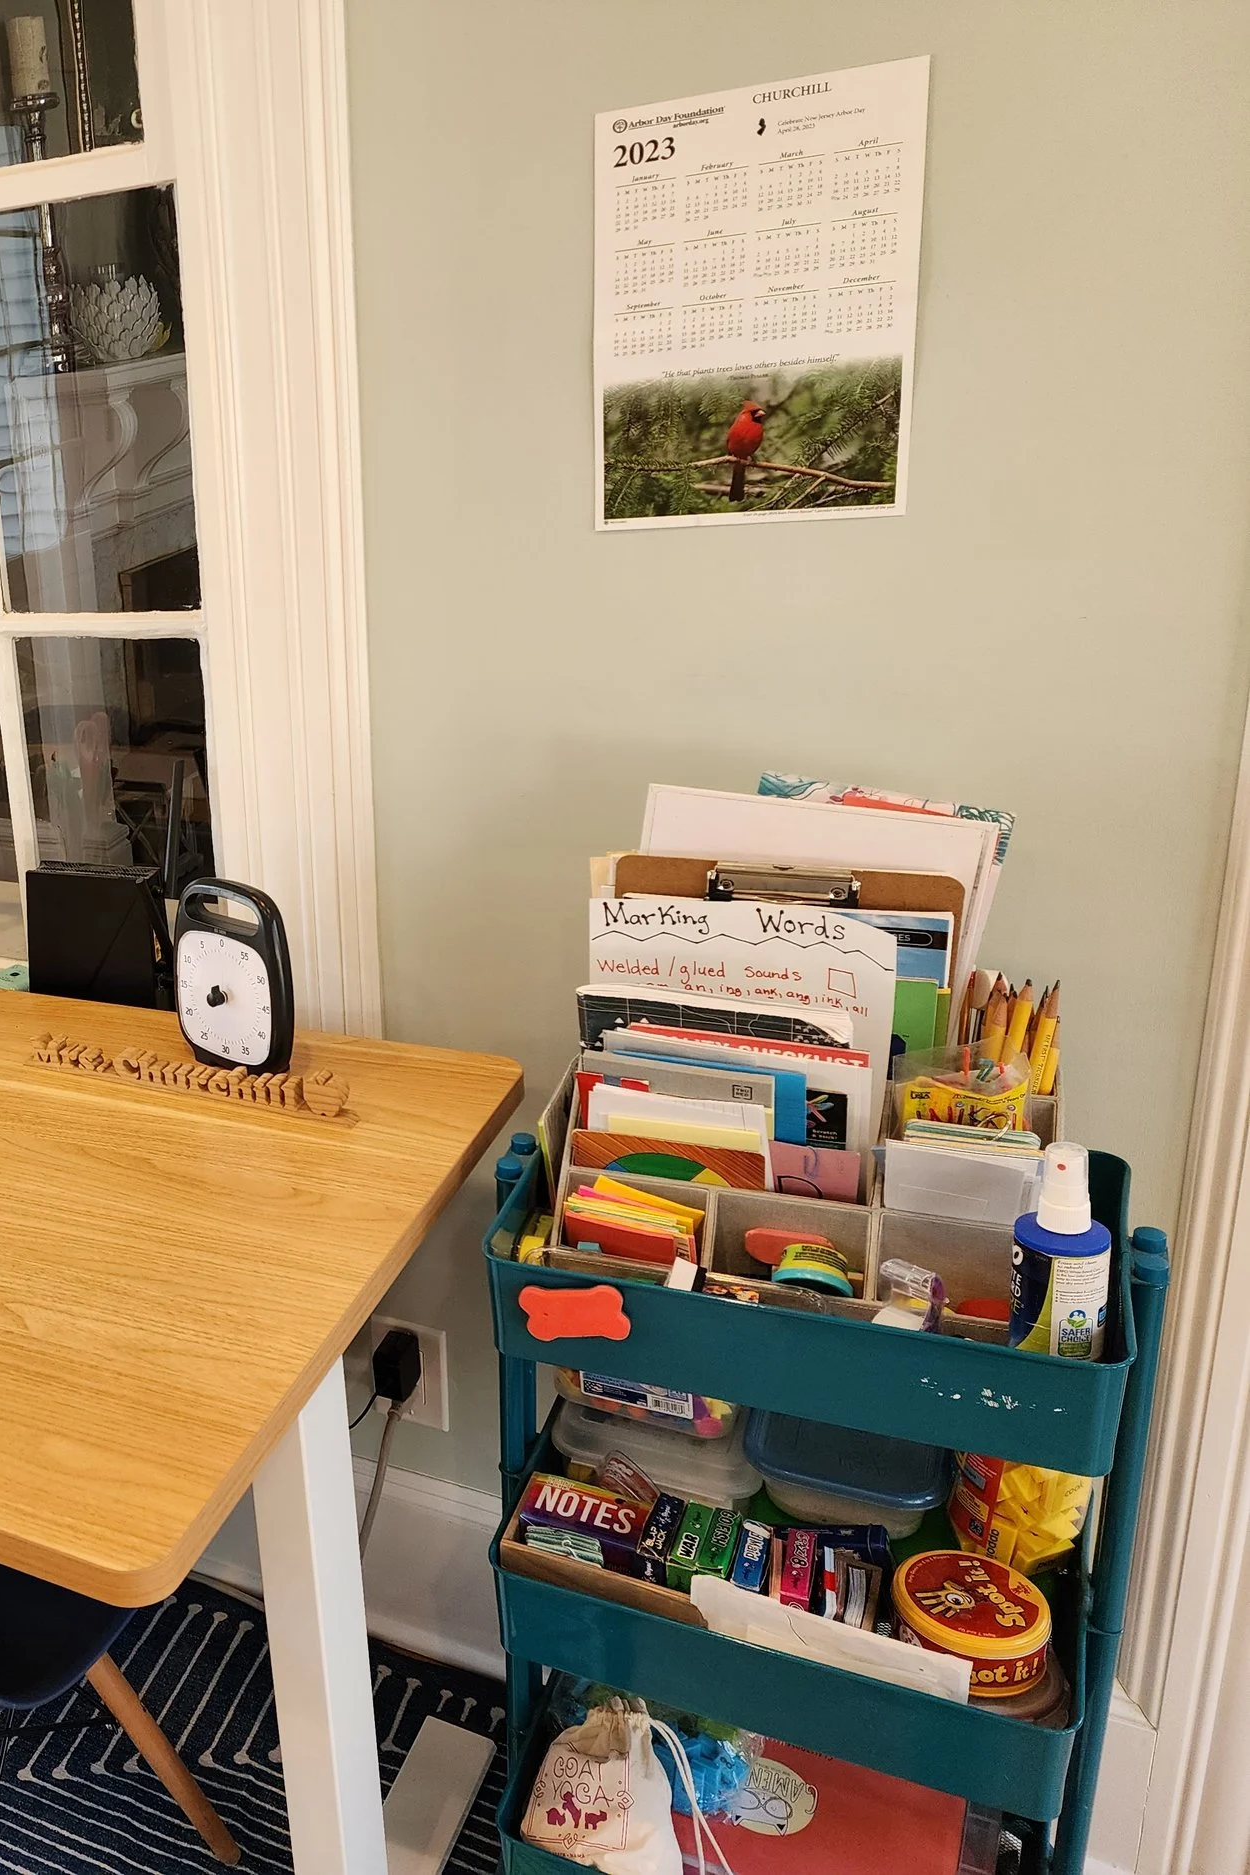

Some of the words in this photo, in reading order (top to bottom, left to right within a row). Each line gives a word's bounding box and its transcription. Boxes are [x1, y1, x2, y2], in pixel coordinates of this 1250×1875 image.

[753, 82, 832, 104] CHURCHILL
[628, 119, 653, 129] Arbor
[656, 115, 673, 125] Day
[674, 106, 724, 121] Foundation
[836, 109, 853, 118] Arbor
[854, 107, 866, 115] Day
[858, 137, 879, 147] April
[613, 137, 676, 168] 2023
[780, 149, 804, 159] March
[701, 161, 734, 172] February
[631, 173, 660, 183] January
[852, 207, 879, 217] August
[781, 218, 797, 227] July
[706, 229, 724, 237] June
[637, 239, 652, 247] May
[843, 274, 881, 285] December
[767, 283, 805, 294] November
[699, 293, 727, 302] October
[626, 301, 661, 311] September
[676, 368, 691, 377] that
[692, 367, 715, 378] plants
[716, 365, 733, 374] trees
[735, 363, 753, 372] loves
[754, 359, 777, 369] others
[779, 356, 805, 367] besides
[602, 901, 710, 935] Marking
[755, 907, 846, 940] Words
[200, 940, 205, 950] 5
[219, 938, 225, 949] 0
[183, 954, 192, 964] 10
[239, 951, 250, 961] 55
[597, 957, 660, 976] Welded
[680, 958, 726, 985] glued
[180, 979, 189, 989] 15
[256, 976, 266, 986] 50
[185, 1007, 194, 1017] 20
[261, 1005, 271, 1015] 45
[852, 1005, 870, 1018] all
[200, 1030, 209, 1041] 25
[257, 1030, 267, 1041] 40
[221, 1044, 230, 1055] 30
[241, 1045, 251, 1056] 35
[1061, 1327, 1091, 1337] SAFER
[1061, 1334, 1090, 1343] CHOICE
[534, 1485, 636, 1534] NOTES
[721, 1509, 737, 1523] GO
[646, 1525, 657, 1547] SLAP
[711, 1519, 732, 1548] FISH
[656, 1529, 668, 1550] JACK
[678, 1533, 699, 1559] WAR
[958, 1560, 991, 1583] it!
[976, 1582, 1026, 1628] Spot
[1014, 1657, 1039, 1682] it!
[553, 1756, 607, 1782] GOAT
[552, 1780, 614, 1808] YOGA
